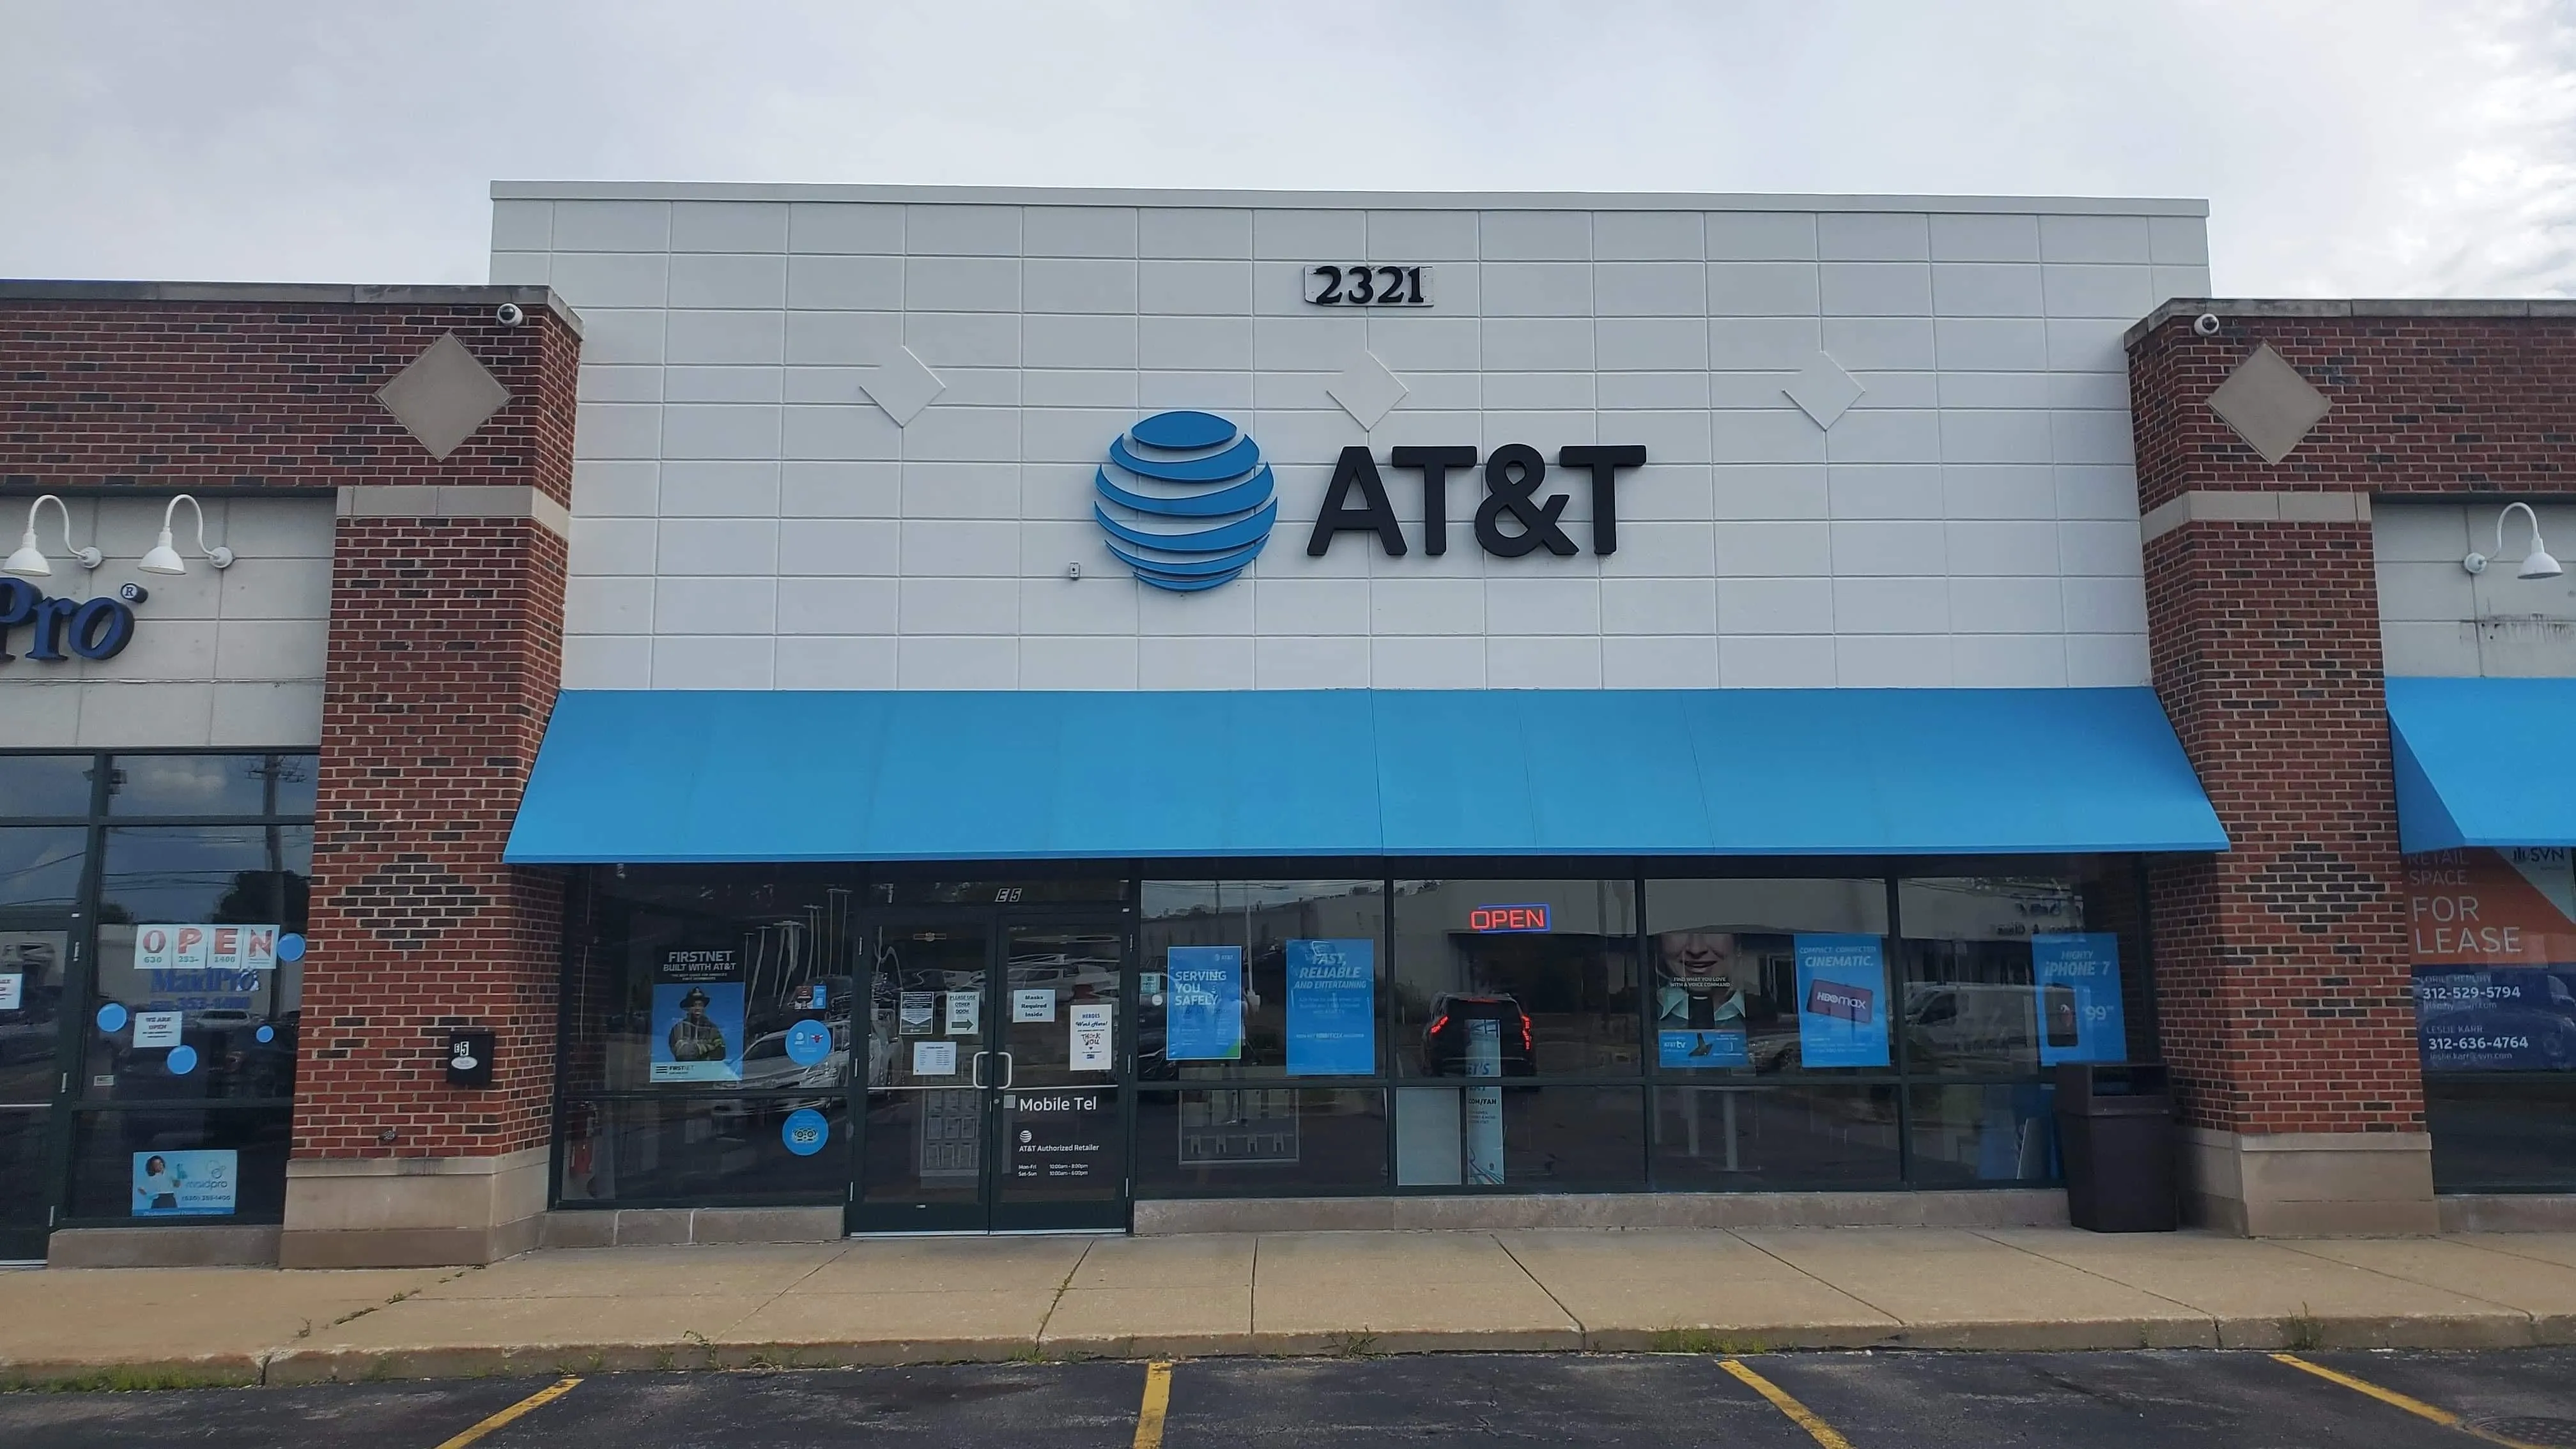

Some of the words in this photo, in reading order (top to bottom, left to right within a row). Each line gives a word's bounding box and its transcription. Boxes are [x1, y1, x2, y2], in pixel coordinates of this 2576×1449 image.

[1313, 265, 1424, 304] 2321
[1306, 443, 1647, 558] AT&T
[2531, 847, 2564, 862] SVN
[2409, 870, 2469, 886] SPACE
[2412, 895, 2480, 923] FOR
[1470, 909, 1545, 930] OPEN
[143, 928, 273, 958] OPEN
[2415, 926, 2523, 954] LEASE
[668, 950, 736, 962] FIRSTNET
[1805, 955, 1874, 967] CINEMATIC.
[2061, 951, 2094, 960] MIGHTY
[663, 963, 687, 972] BUILT
[688, 963, 711, 971] WITH
[713, 962, 737, 970] AT&T
[1299, 967, 1362, 979] RELIABLE
[2045, 961, 2097, 976] iPHONE
[2101, 961, 2111, 976] 7
[1175, 970, 1227, 981] SERVING
[1176, 982, 1200, 993] YOU
[1294, 981, 1313, 989] AND
[1315, 980, 1367, 989] ENTERTAINING
[2423, 986, 2521, 1000] 312-529-5794
[1175, 995, 1219, 1006] SAFELY
[2428, 1036, 2529, 1050] 312-636-4764
[1020, 1096, 1070, 1112] Mobile
[1074, 1096, 1097, 1110] Tel
